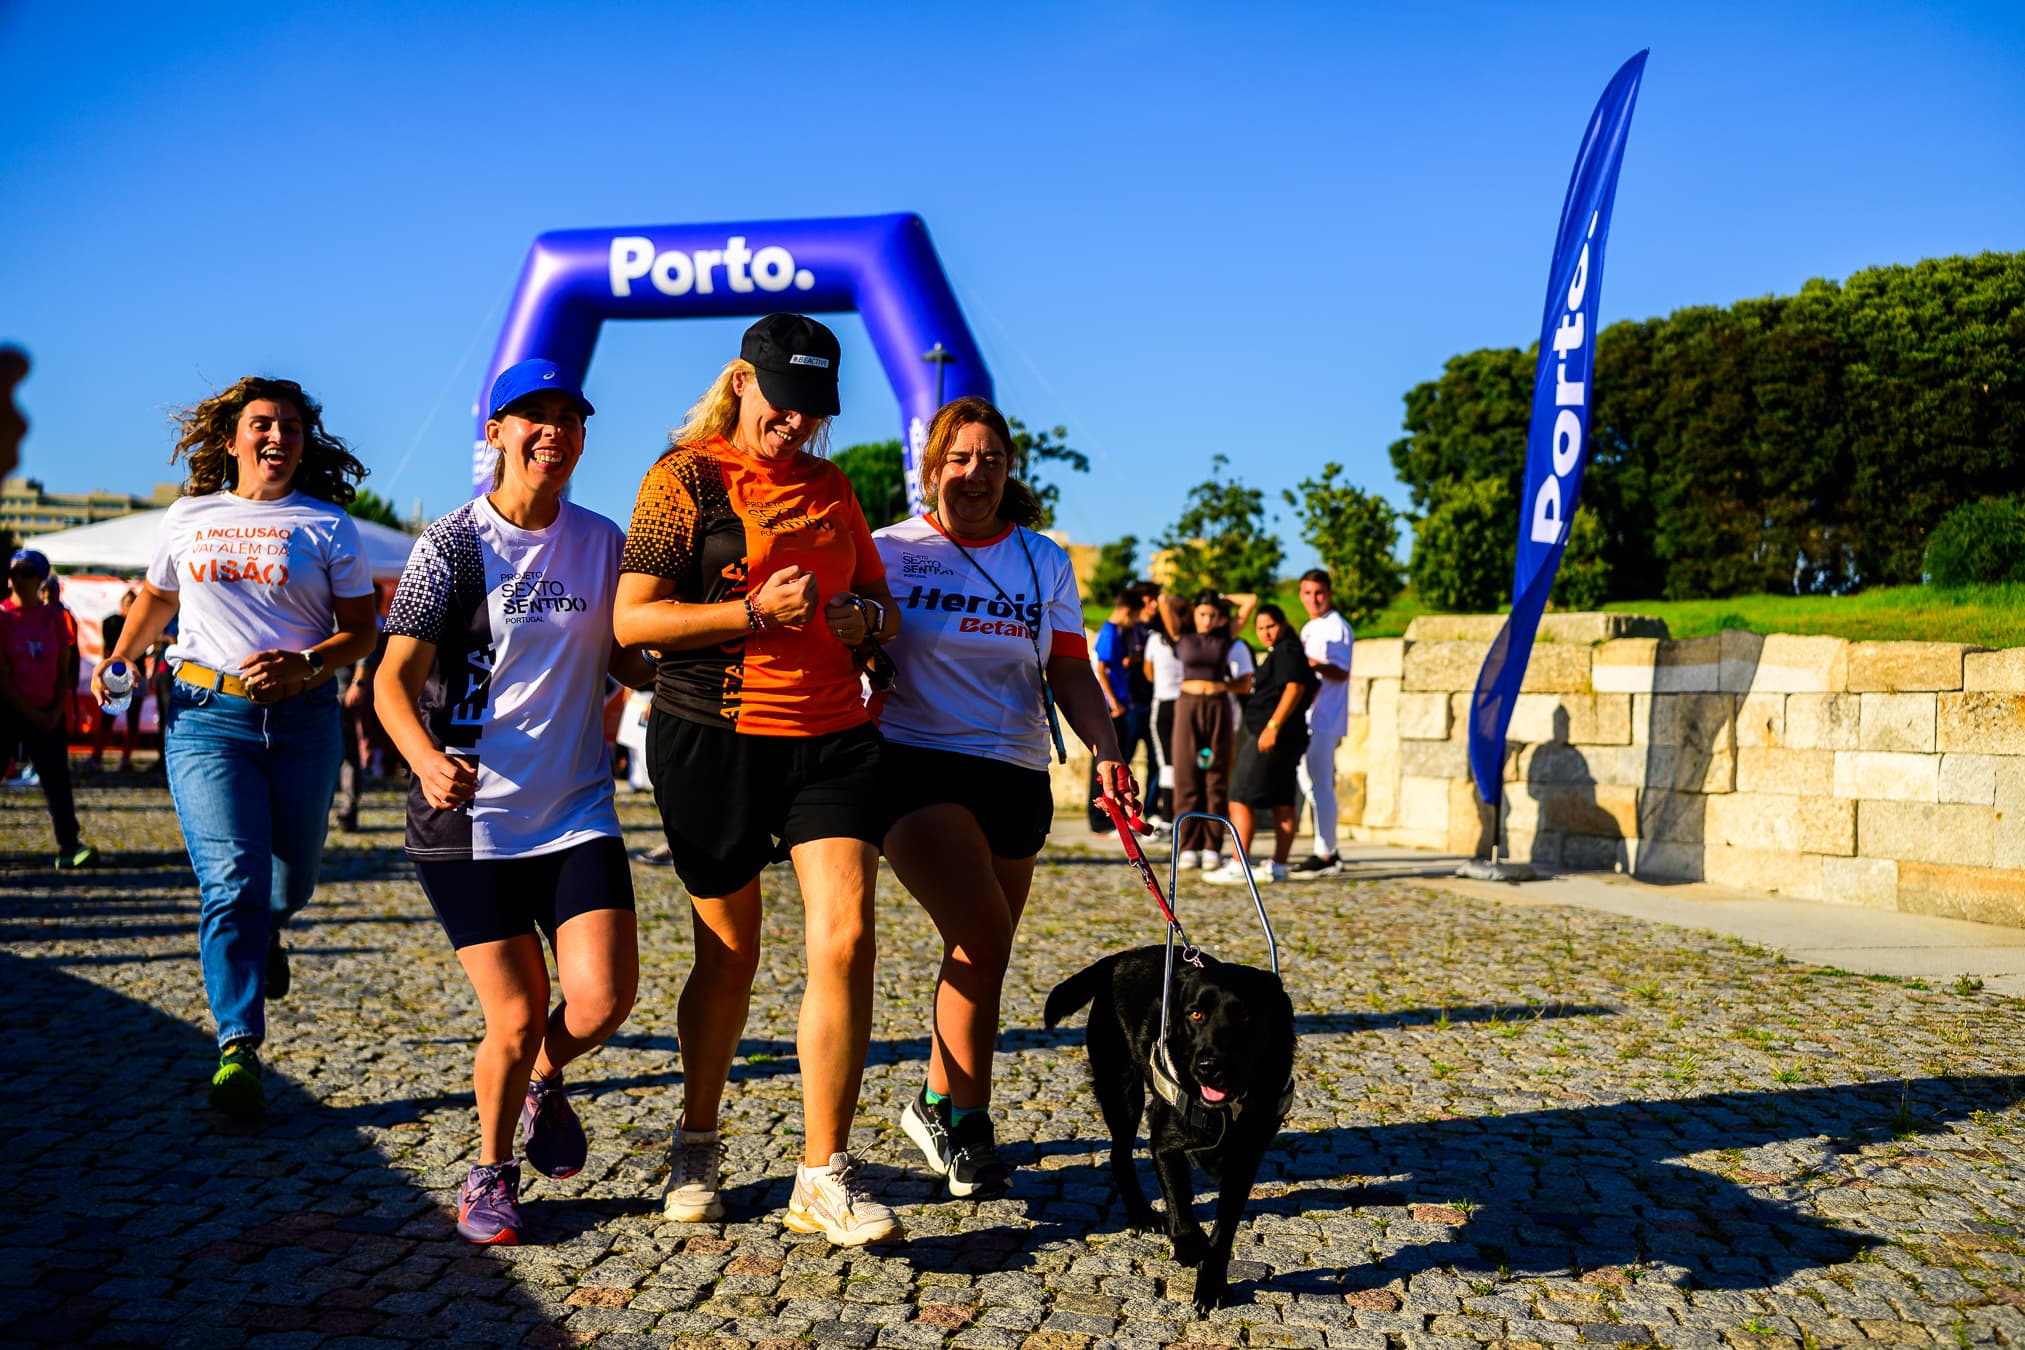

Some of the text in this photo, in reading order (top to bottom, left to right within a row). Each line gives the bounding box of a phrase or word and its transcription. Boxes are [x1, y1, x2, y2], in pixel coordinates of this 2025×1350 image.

[609, 236, 815, 297] Porto.
[1530, 210, 1599, 545] Porto.
[195, 525, 291, 541] A INCLUSÃO
[192, 543, 213, 555] VAI
[267, 543, 289, 557] DA
[188, 556, 288, 587] VISÃO
[500, 571, 543, 581] PROJETO
[501, 580, 565, 598] SEXTO
[503, 597, 587, 615] SENTIDO
[505, 615, 544, 624] PORTUGAL
[445, 643, 494, 815] LETA
